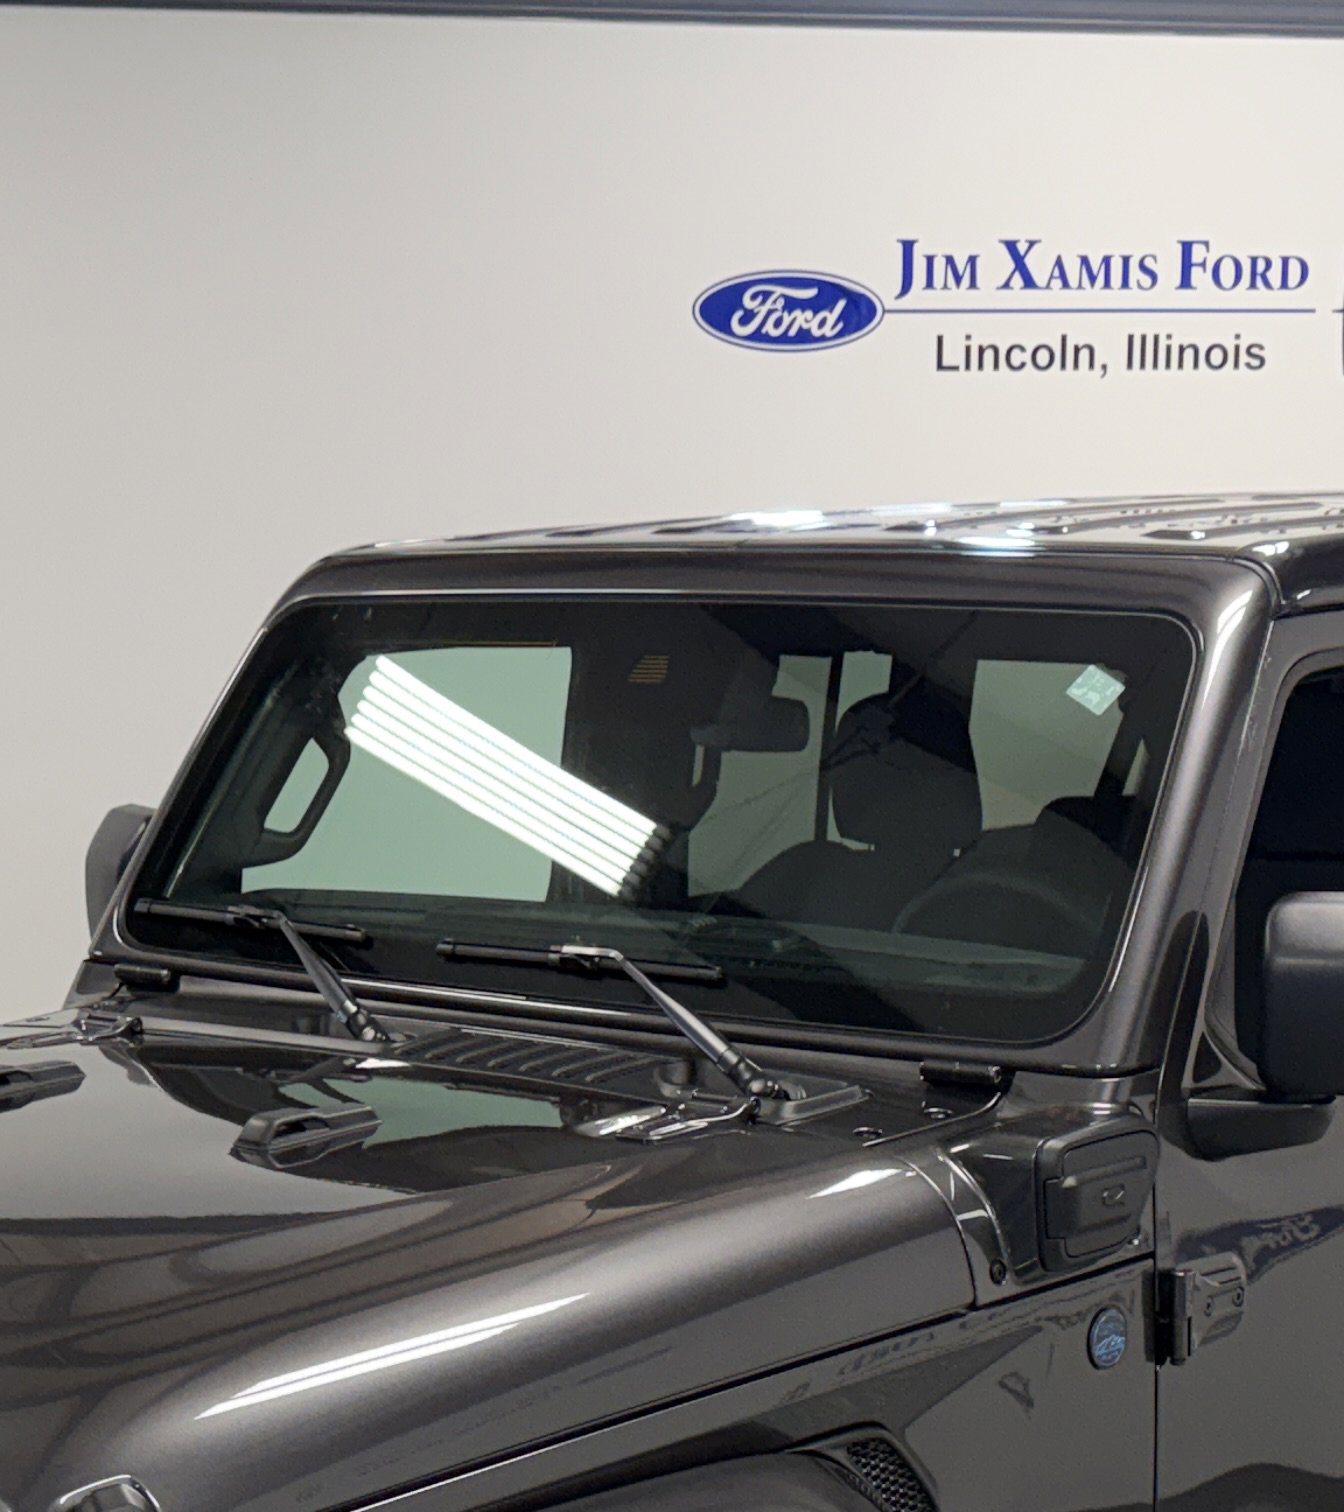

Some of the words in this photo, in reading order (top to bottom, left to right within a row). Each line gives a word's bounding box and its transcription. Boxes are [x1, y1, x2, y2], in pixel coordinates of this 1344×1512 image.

[894, 239, 981, 300] JIM
[996, 239, 1158, 291] XAMIS
[1175, 240, 1311, 291] FORD
[730, 284, 847, 337] Ford
[935, 334, 1108, 378] Lincoln,
[1125, 333, 1267, 371] Illinois
